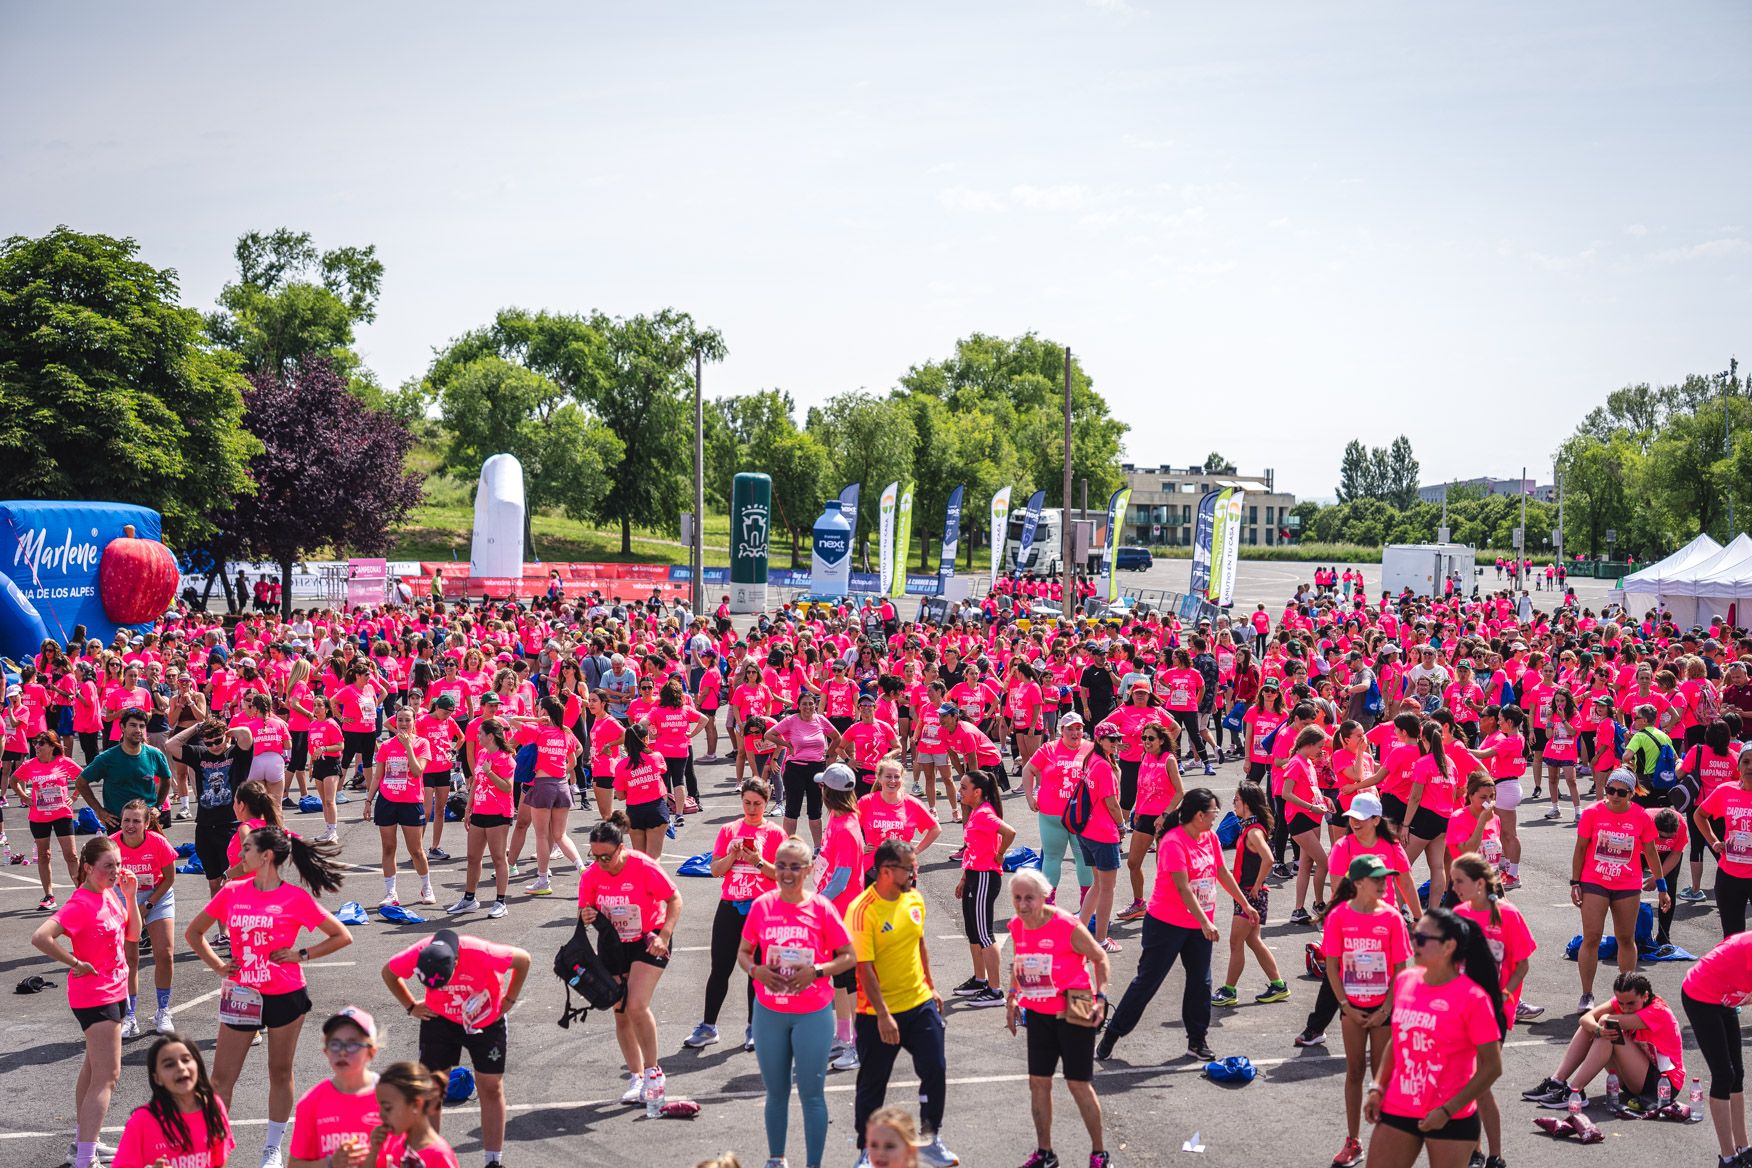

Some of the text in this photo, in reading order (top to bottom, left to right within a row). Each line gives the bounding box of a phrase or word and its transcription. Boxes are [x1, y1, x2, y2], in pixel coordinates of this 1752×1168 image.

[819, 539, 845, 549] next
[13, 527, 98, 586] Marlene
[1227, 548, 1233, 558] TU
[1226, 560, 1232, 571] EN
[36, 588, 50, 599] DE
[51, 587, 68, 598] LOS
[69, 586, 95, 597] ALPES
[1224, 572, 1232, 602] AMUTIO
[253, 734, 283, 743] MPARABLES
[546, 739, 564, 747] SOMOS
[1709, 760, 1730, 769] SOMOS
[630, 765, 653, 778] SOMOS
[873, 819, 904, 830] CARRERA
[121, 863, 152, 873] ARRERA
[1595, 864, 1622, 877] MUJER
[597, 895, 630, 905] CARRERA
[230, 914, 274, 928] CARRERA
[254, 931, 268, 946] DE
[765, 926, 809, 940] CARRERA
[1343, 937, 1382, 950] CARRERA
[240, 968, 272, 983] MUJER
[1356, 971, 1373, 979] 016
[230, 1001, 248, 1010] 016
[1392, 1007, 1437, 1031] CARRERA
[320, 1132, 369, 1150] CARRER
